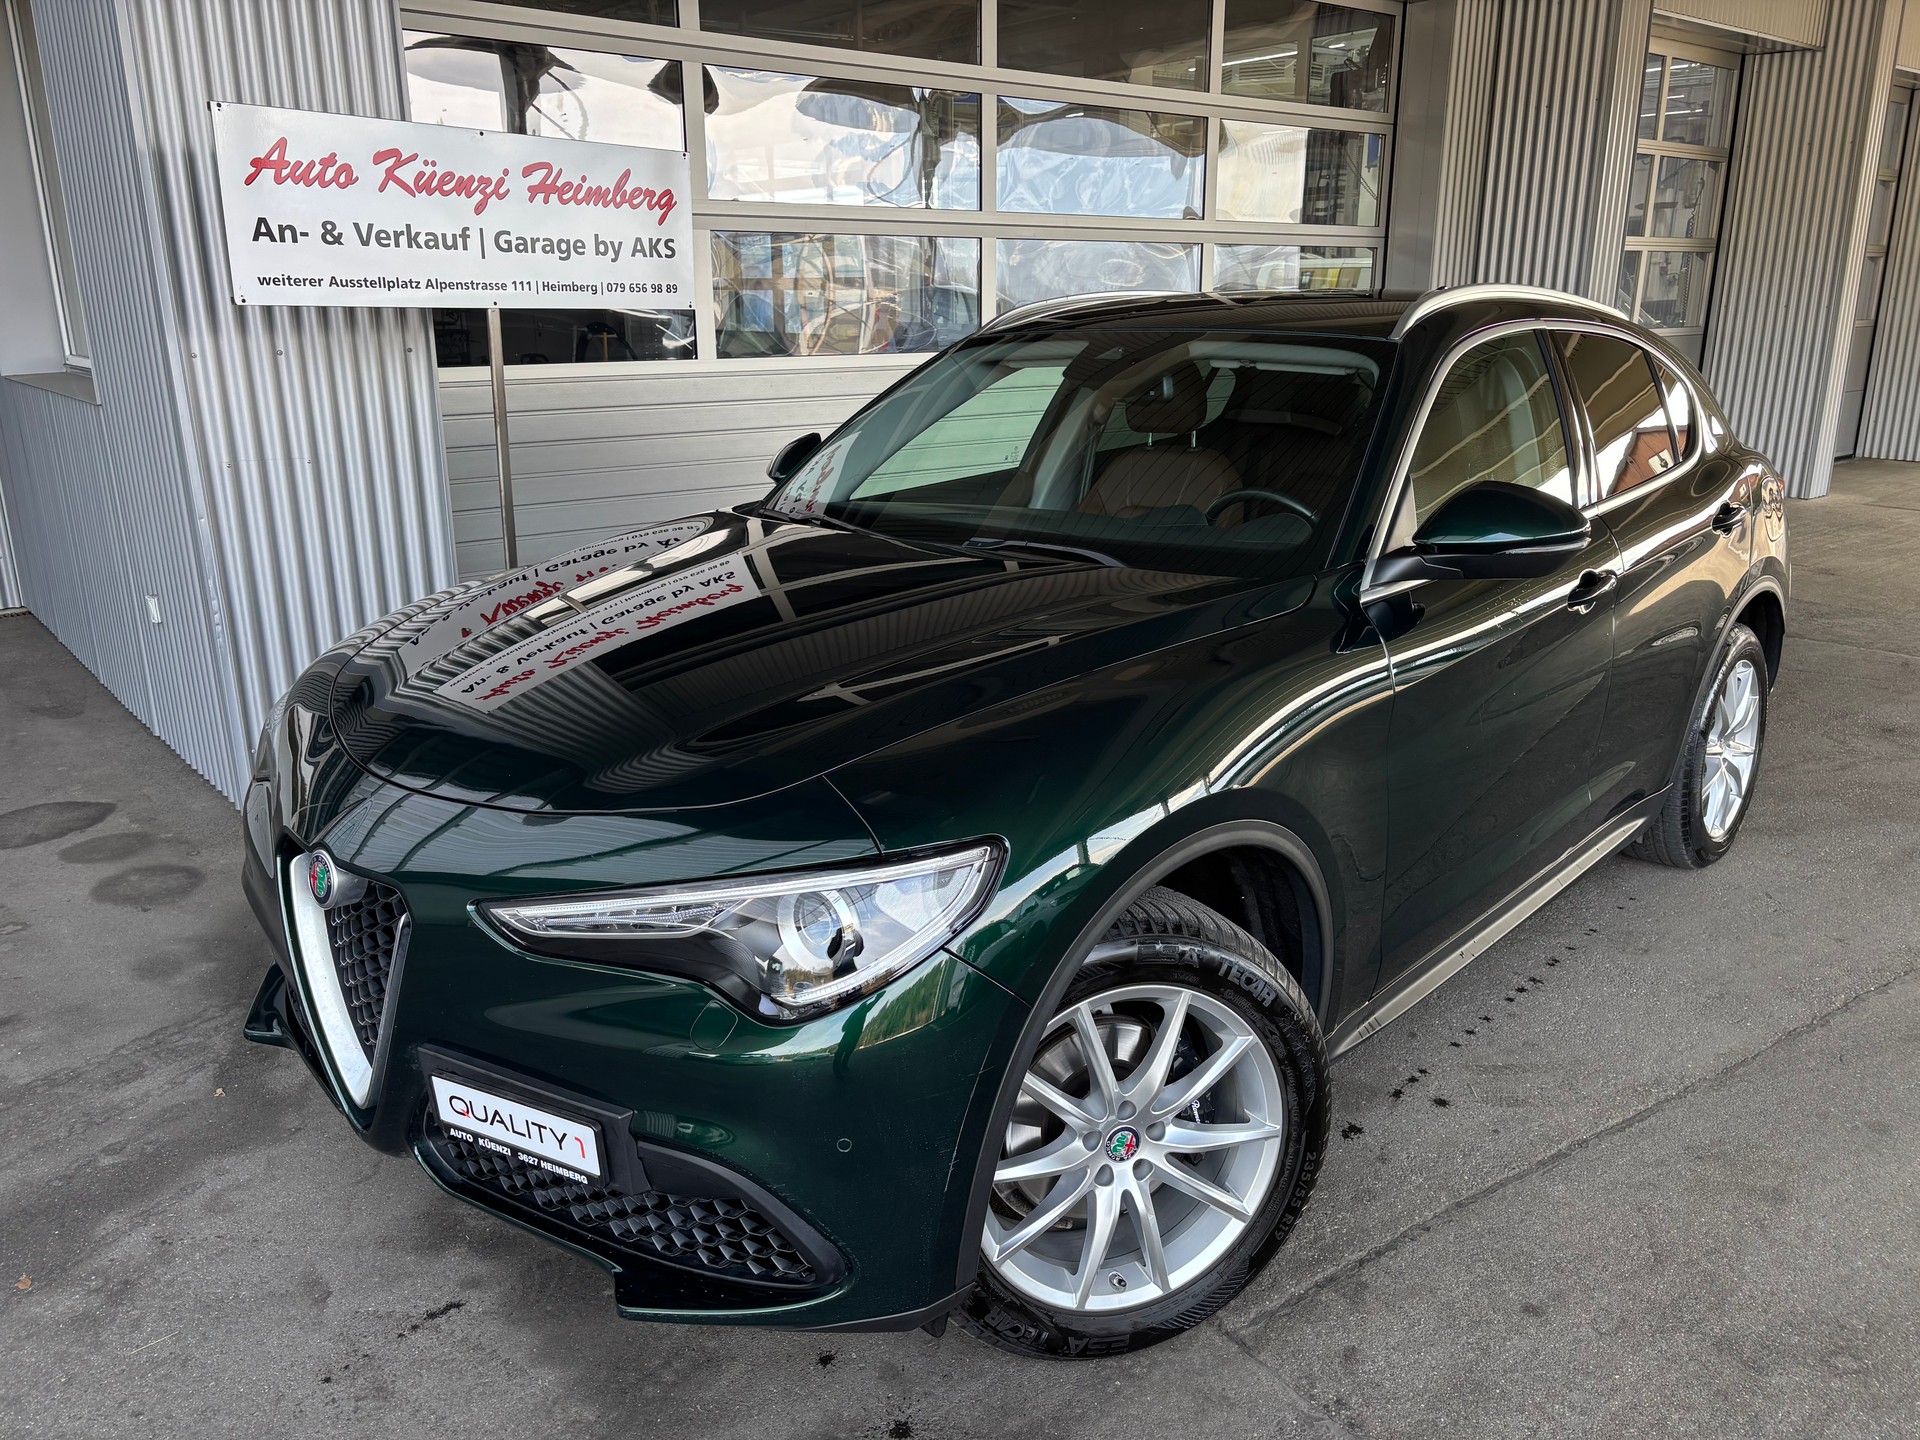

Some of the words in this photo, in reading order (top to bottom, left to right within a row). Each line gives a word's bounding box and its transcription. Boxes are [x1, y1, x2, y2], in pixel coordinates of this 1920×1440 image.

[244, 137, 360, 188] Auto
[371, 147, 512, 216] Küenzi
[520, 161, 678, 227] Heimberg
[251, 217, 310, 244] An-
[321, 221, 345, 246] &
[353, 223, 471, 251] Verkauf
[494, 231, 586, 262] Garage
[595, 233, 623, 263] by
[631, 236, 677, 259] AKS
[257, 274, 324, 288] weiterer
[328, 275, 422, 292] Ausstellplatz
[425, 279, 508, 293] Alpenstrasse
[511, 281, 533, 292] 111
[541, 281, 598, 296] Heimberg
[606, 282, 627, 294] 079
[629, 283, 648, 294] 656
[650, 283, 663, 294] 98
[666, 283, 678, 294] 89
[1217, 955, 1278, 1008] TECAR
[449, 1095, 568, 1151] QUALITY
[450, 1128, 474, 1143] AUTO
[478, 1137, 512, 1157] KÜENZI
[517, 1152, 539, 1166] 3627
[540, 1160, 589, 1185] HEIMBERG
[1290, 1151, 1317, 1208] 235/55
